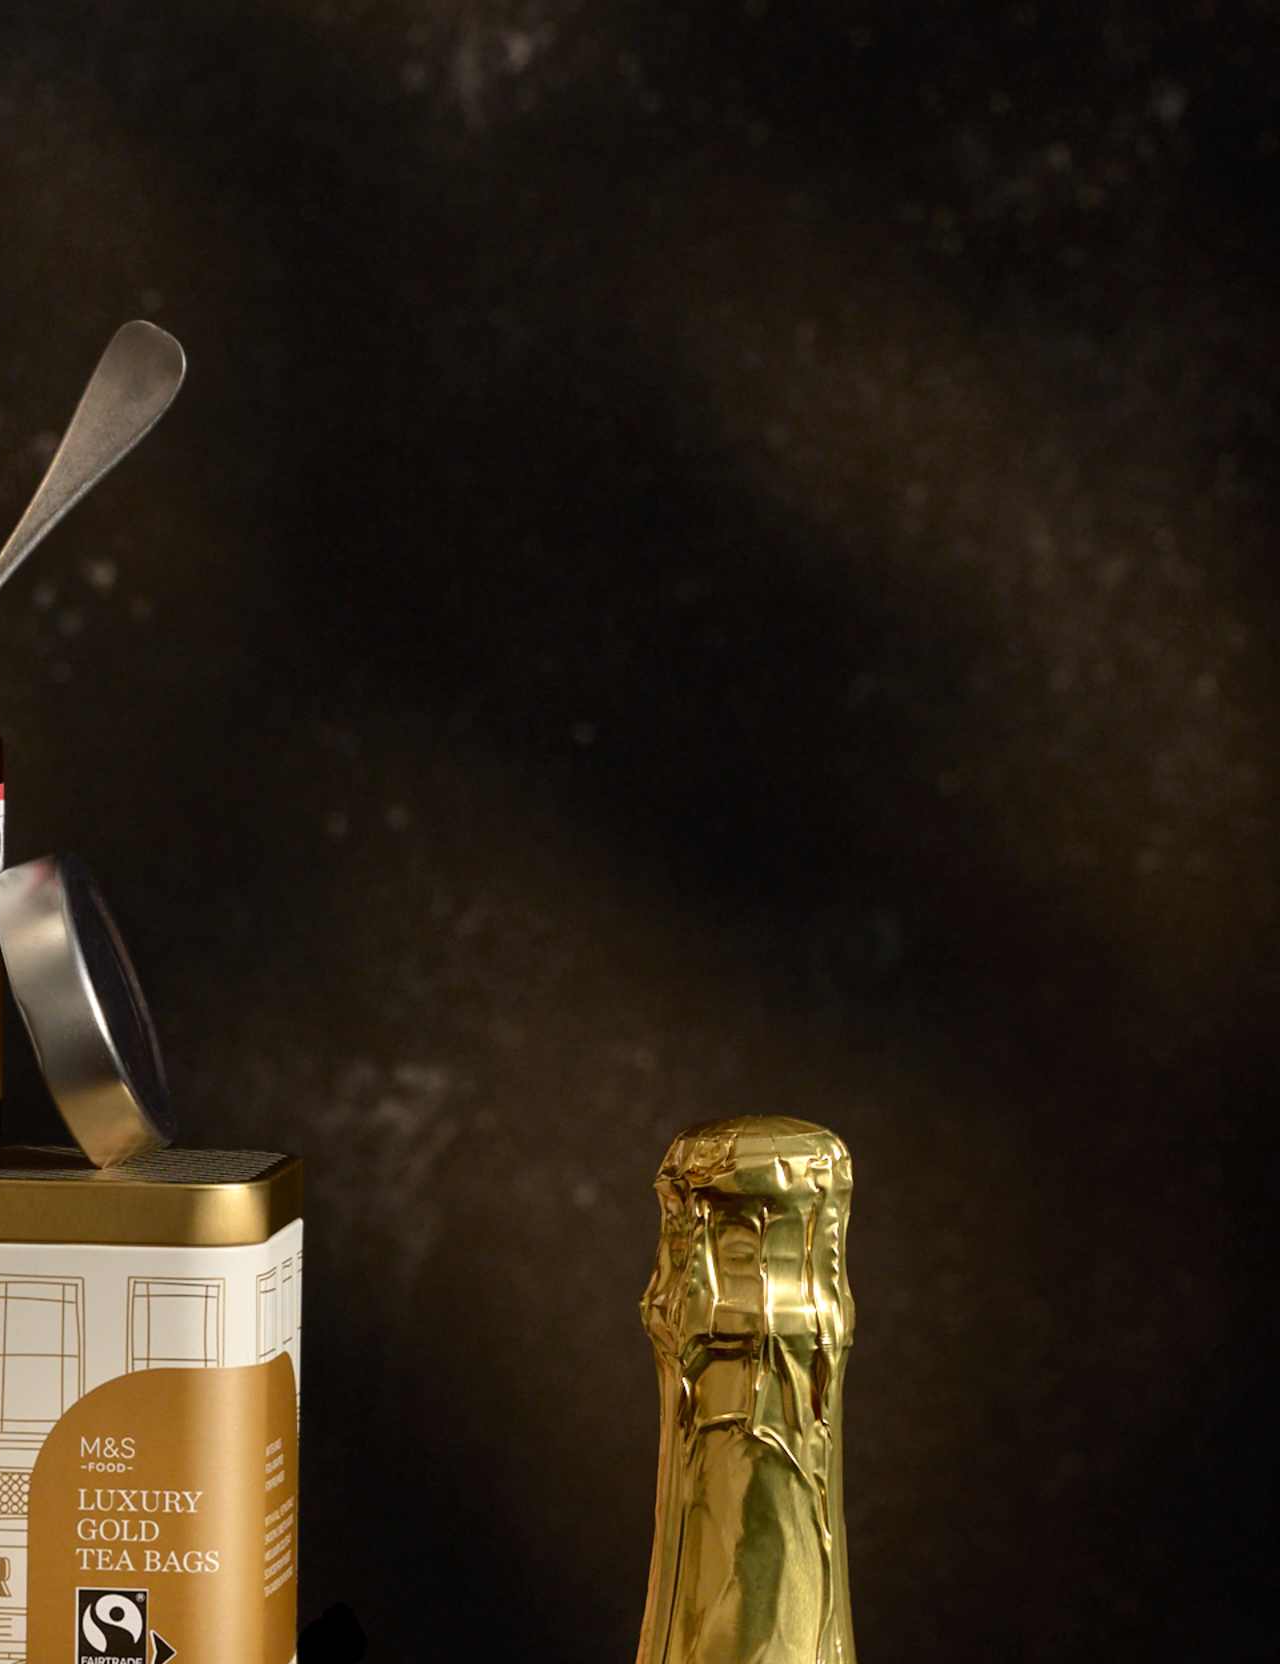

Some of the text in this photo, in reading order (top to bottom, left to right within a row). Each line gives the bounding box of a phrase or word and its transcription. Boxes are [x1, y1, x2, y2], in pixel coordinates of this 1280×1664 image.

[79, 1436, 136, 1459] M&S
[87, 1463, 126, 1472] FOOD
[77, 1488, 204, 1514] LUXURY
[76, 1518, 160, 1542] GOLD
[76, 1548, 221, 1573] TEA BAGS
